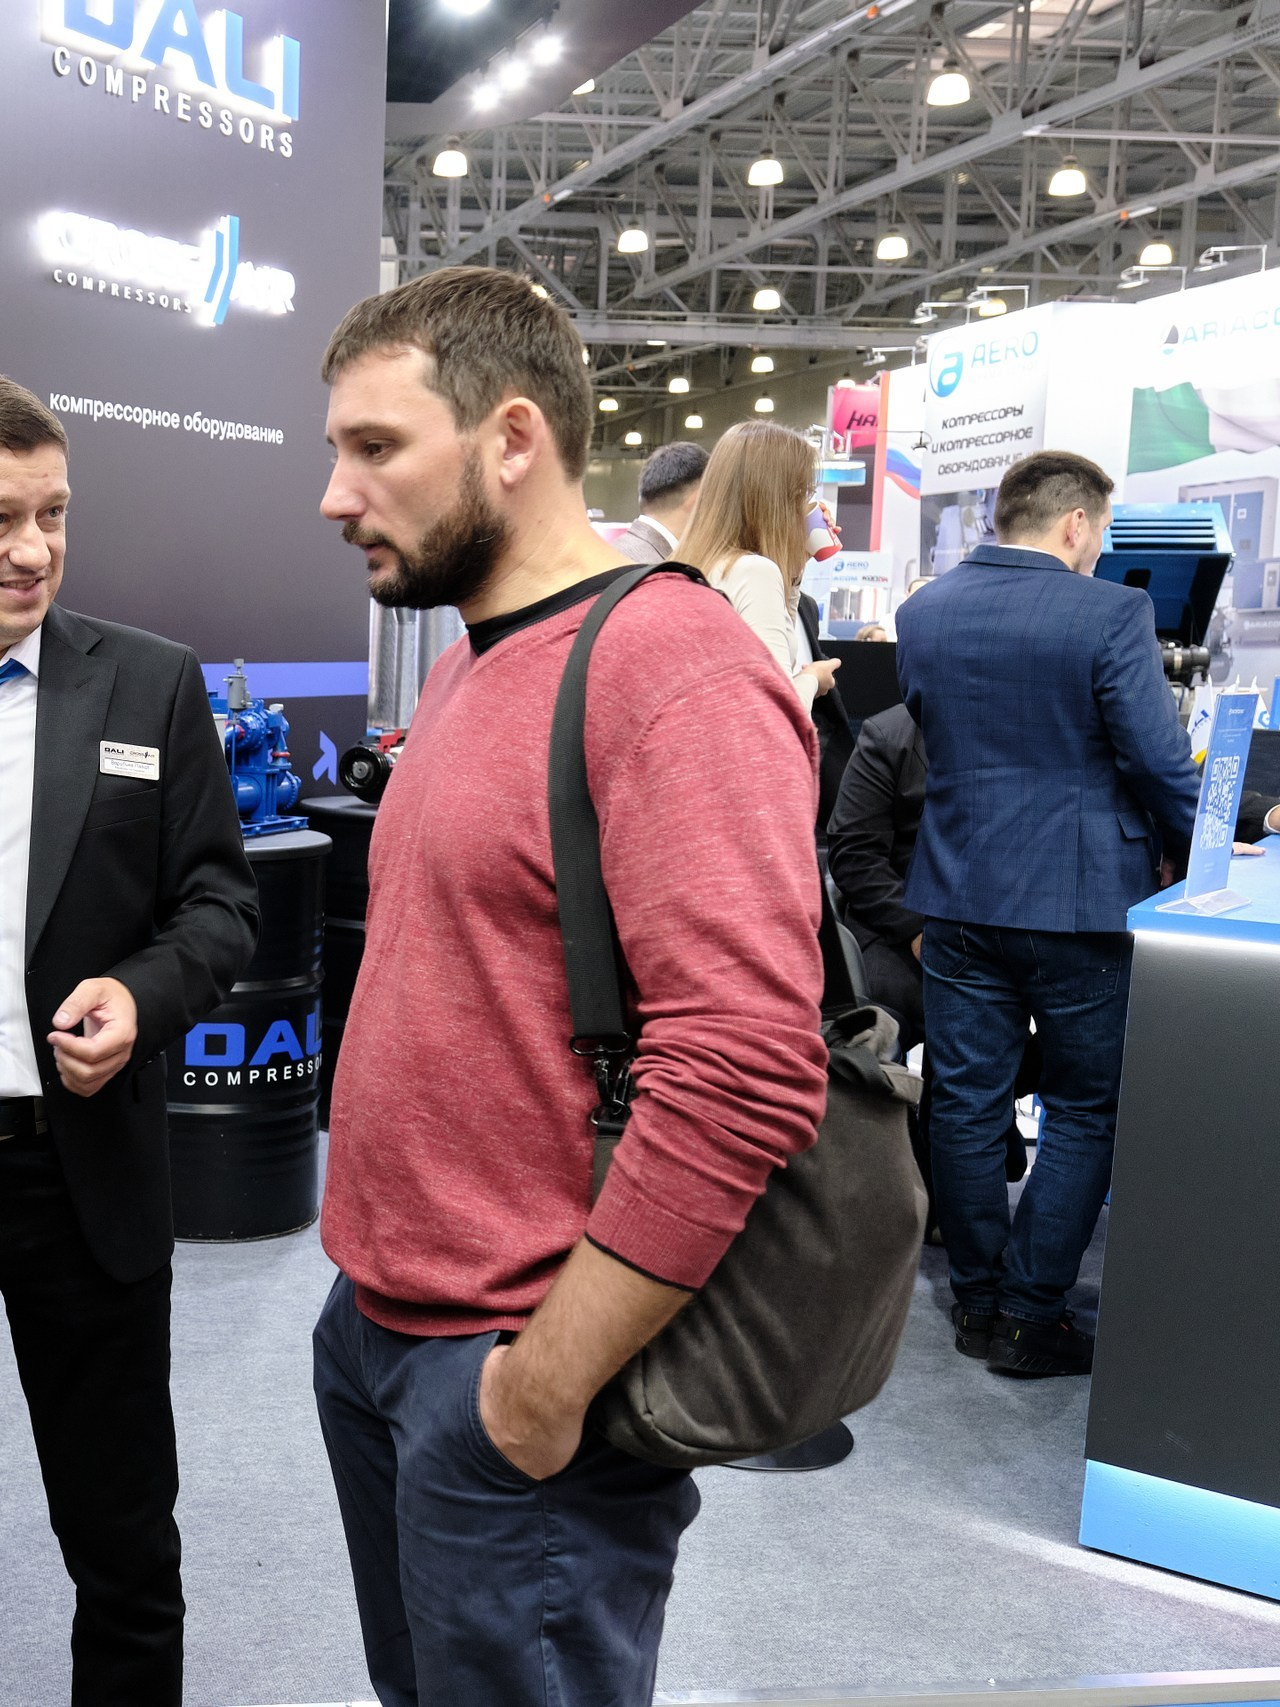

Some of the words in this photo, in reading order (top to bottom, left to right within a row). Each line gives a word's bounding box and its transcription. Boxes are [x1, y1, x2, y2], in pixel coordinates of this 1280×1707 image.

[53, 46, 293, 158] COMPRESSORS
[53, 269, 192, 313] COMPRESSORS
[971, 331, 1039, 368] AERO
[49, 393, 180, 429] компрессорное
[183, 411, 284, 445] оборудование
[846, 410, 879, 430] HA
[941, 404, 1024, 430] КОМПРЕССОРЫ
[939, 426, 1034, 453] КОМПРЕССОРНОЕ
